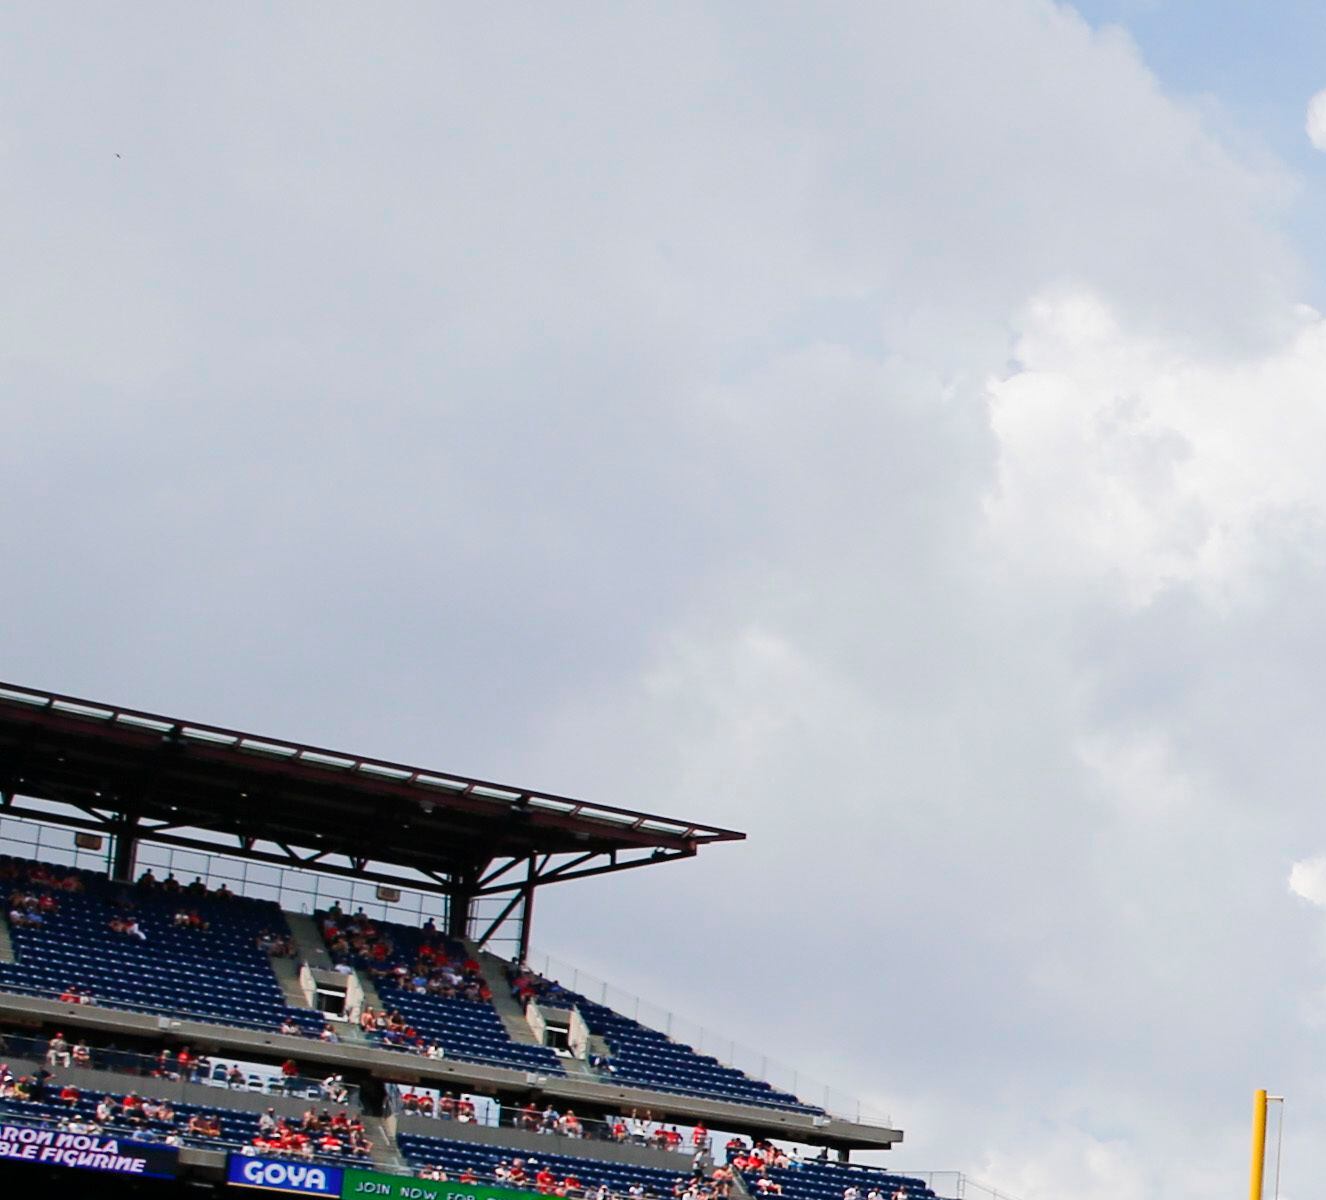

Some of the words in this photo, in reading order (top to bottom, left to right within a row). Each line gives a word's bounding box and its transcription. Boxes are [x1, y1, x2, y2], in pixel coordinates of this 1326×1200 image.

[56, 1134, 119, 1154] NOLA
[41, 1147, 146, 1173] FIGURINE
[243, 1161, 326, 1190] GOYA
[355, 1182, 390, 1195] JOIN
[401, 1187, 437, 1200] NOW
